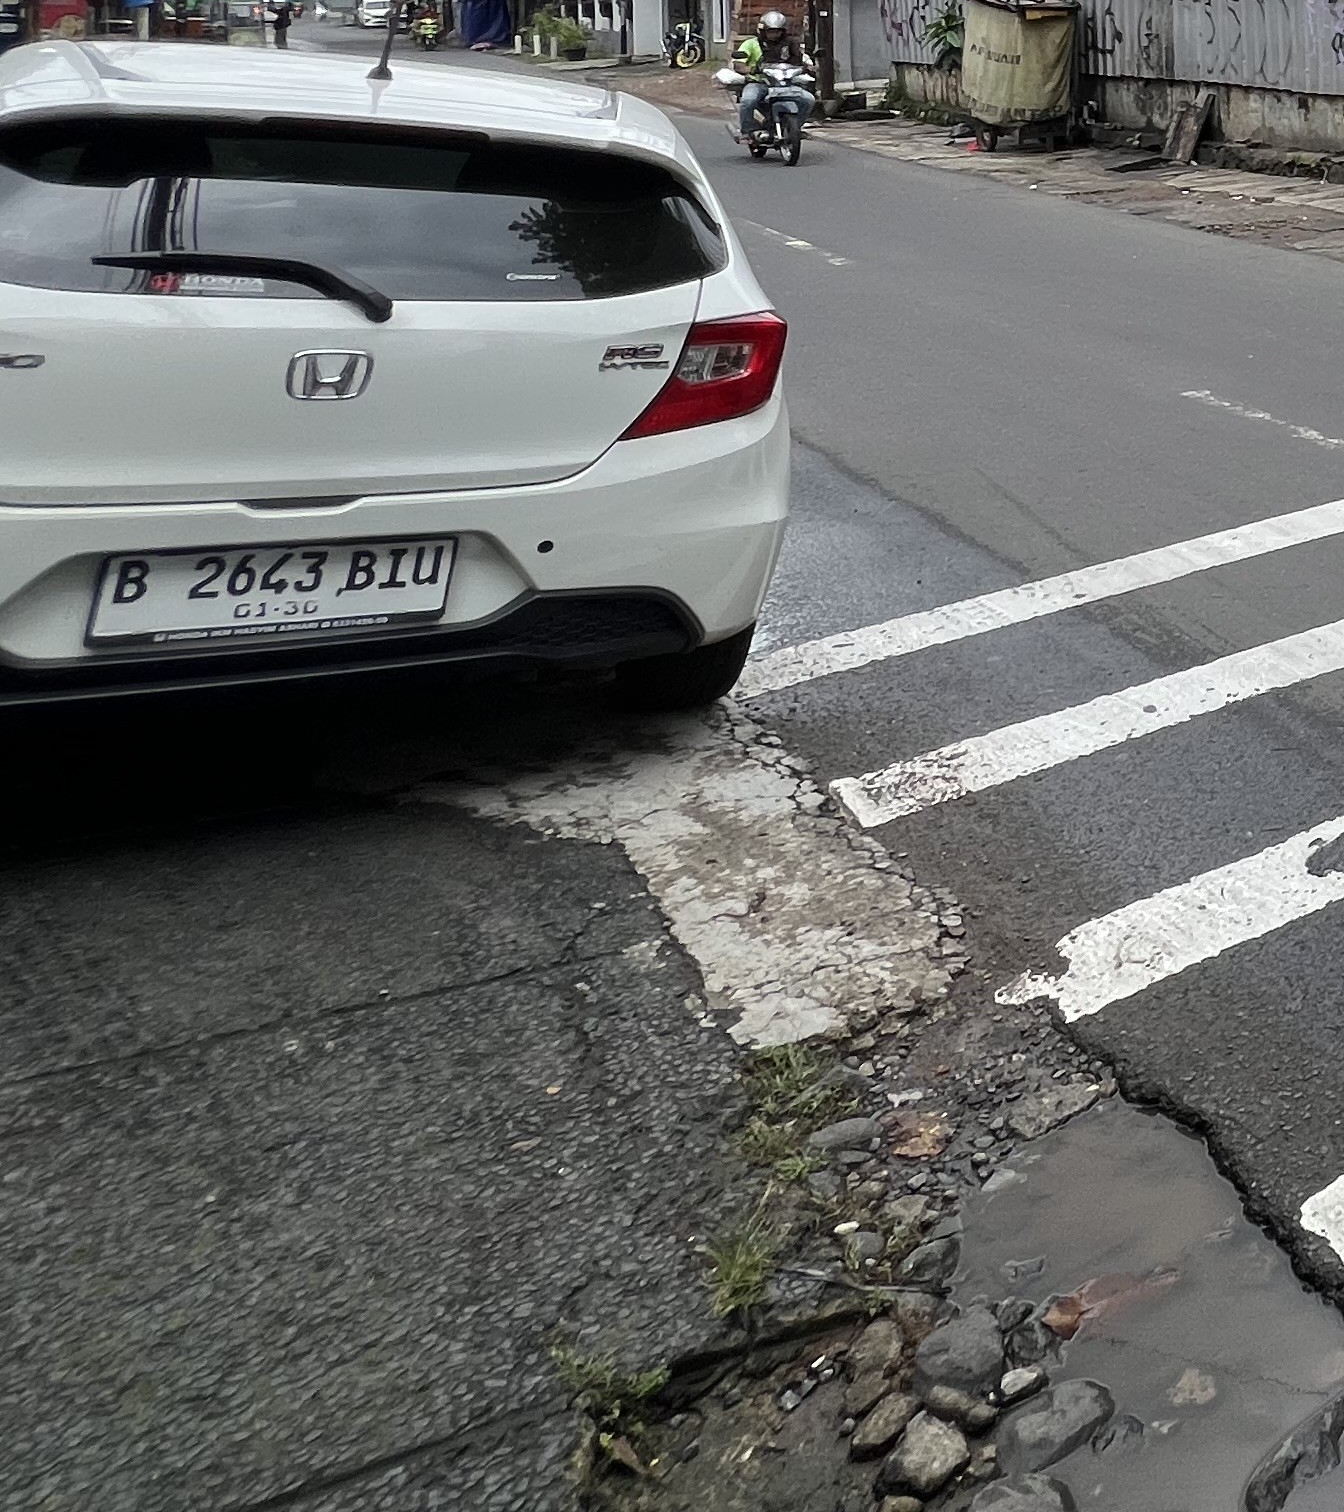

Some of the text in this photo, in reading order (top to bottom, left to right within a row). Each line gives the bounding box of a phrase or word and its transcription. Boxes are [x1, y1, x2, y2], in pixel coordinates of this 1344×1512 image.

[112, 545, 445, 604] B 2643 BIU
